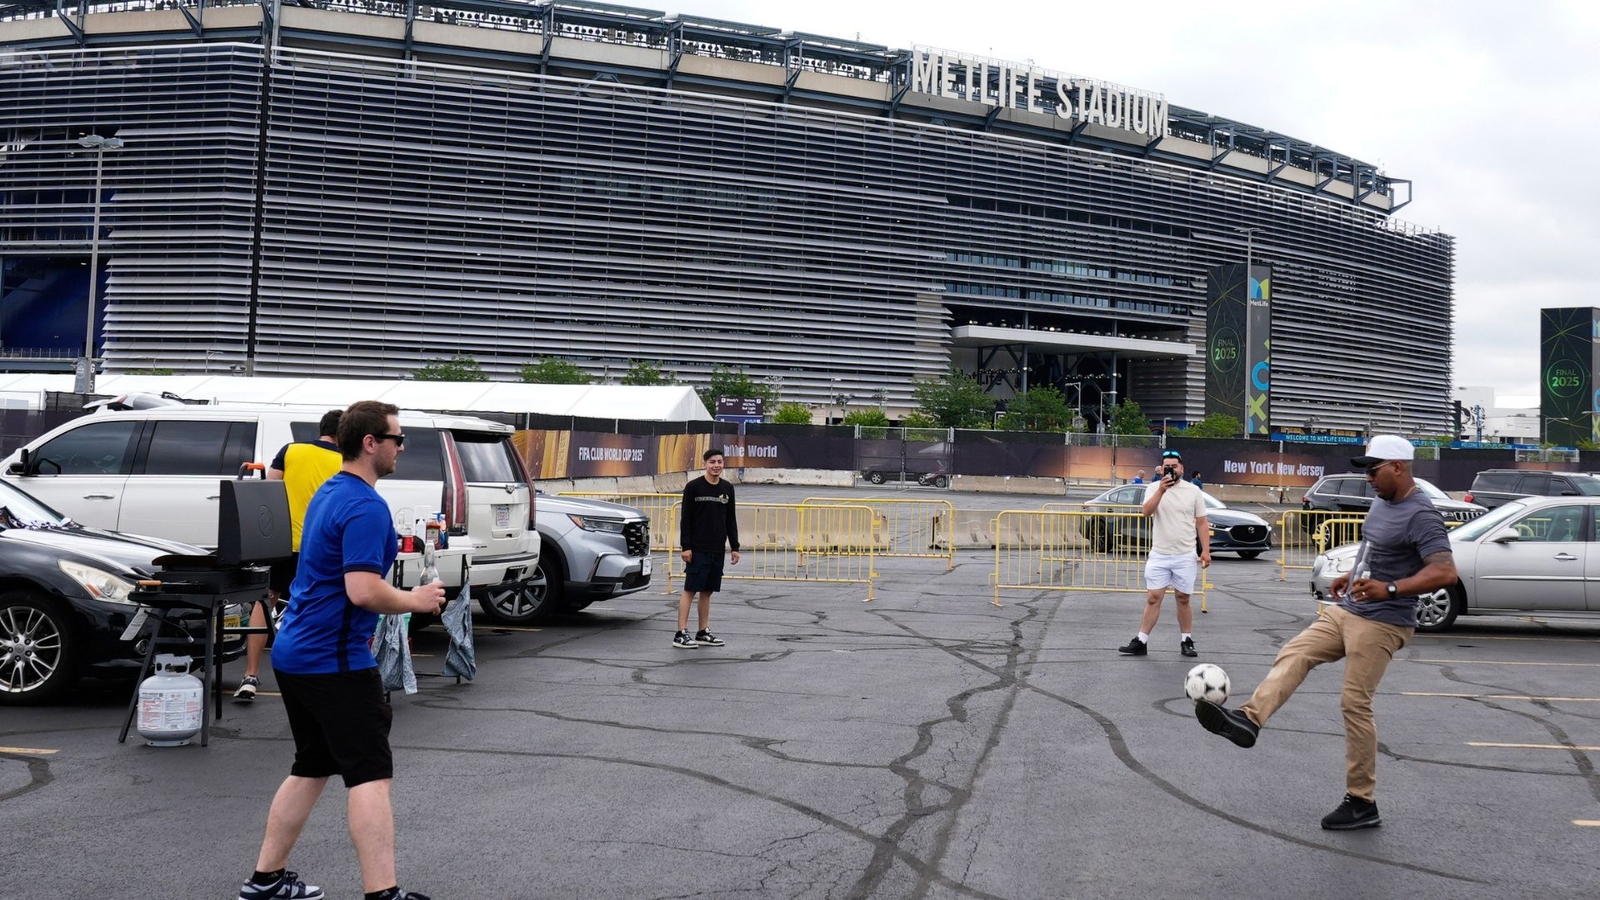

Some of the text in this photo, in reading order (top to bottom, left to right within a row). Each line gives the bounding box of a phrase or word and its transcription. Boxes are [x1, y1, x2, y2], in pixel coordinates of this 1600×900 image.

[912, 50, 1169, 138] METLIFE STADIUM
[1218, 339, 1233, 347] FINAL
[1215, 347, 1236, 360] 2025
[1552, 377, 1580, 387] 2025
[578, 447, 590, 461] FIFA
[590, 447, 604, 461] CLUB
[604, 447, 622, 461] WORLD
[622, 448, 632, 462] CUP
[747, 445, 778, 458] World
[1224, 460, 1325, 477] New York New Jersey
